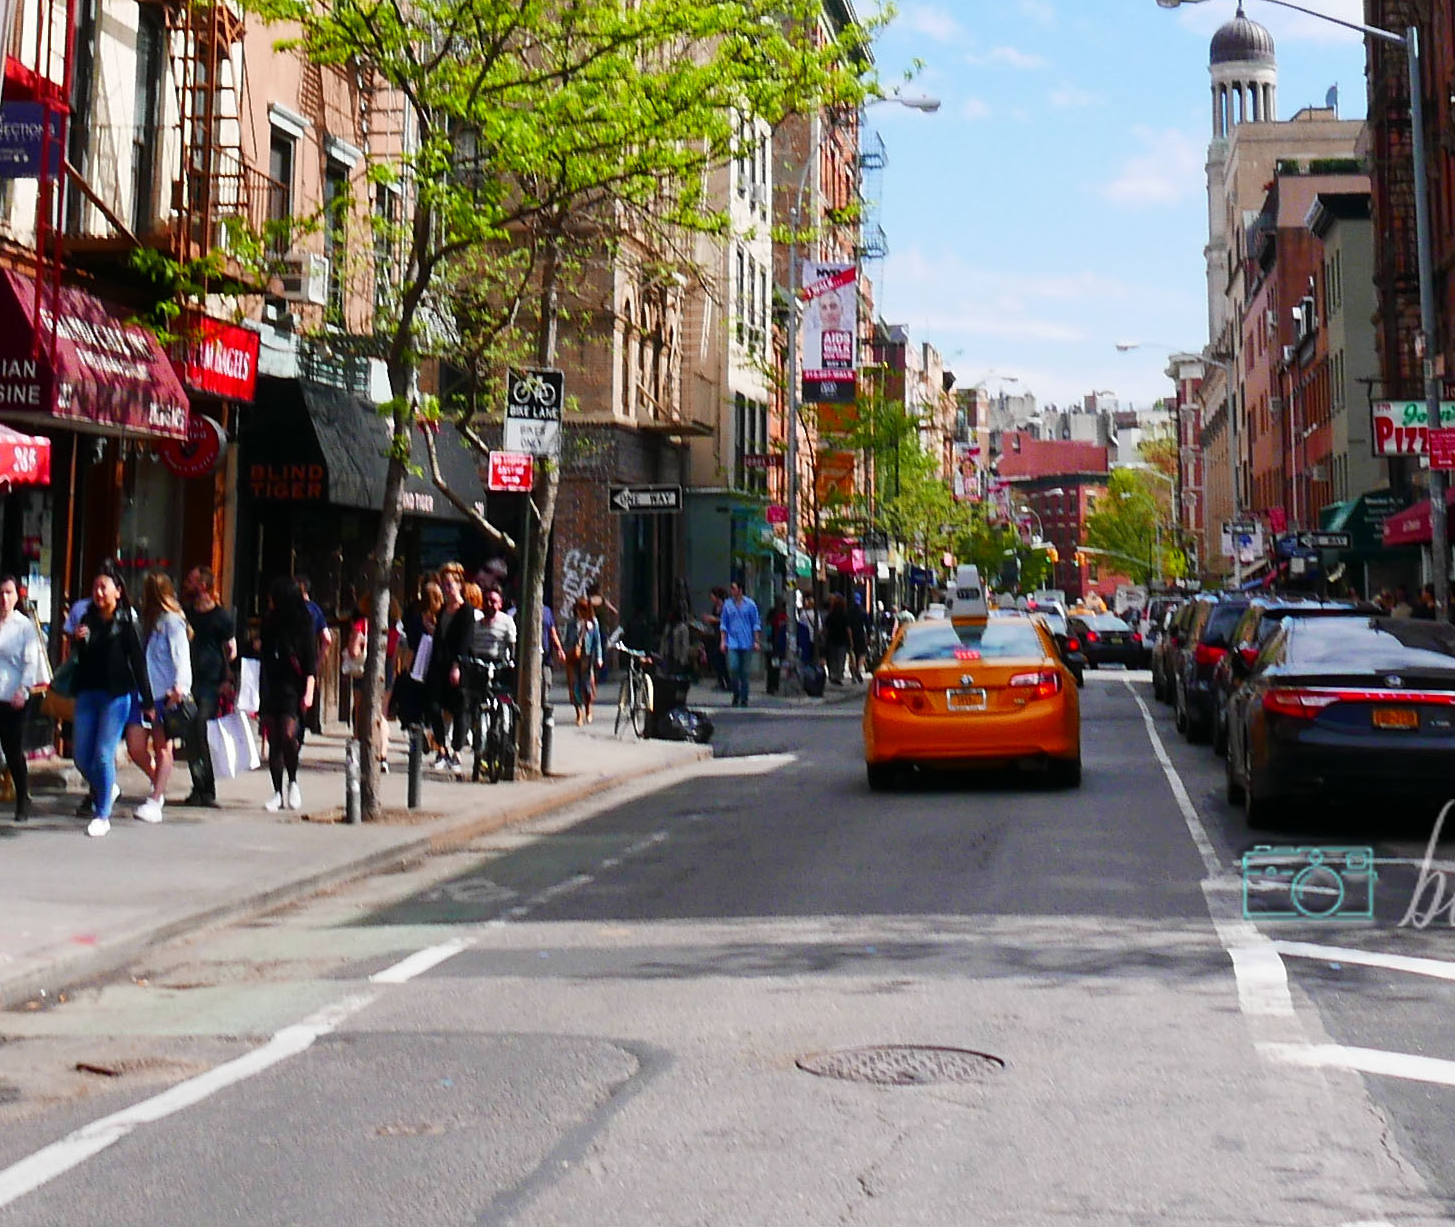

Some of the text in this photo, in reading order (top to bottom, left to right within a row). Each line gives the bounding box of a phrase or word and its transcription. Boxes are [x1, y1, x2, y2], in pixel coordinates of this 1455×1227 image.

[509, 404, 558, 419] BIKE LANE
[250, 463, 324, 480] BLIND
[250, 481, 323, 499] TIGER
[620, 492, 672, 505] ONE WAY
